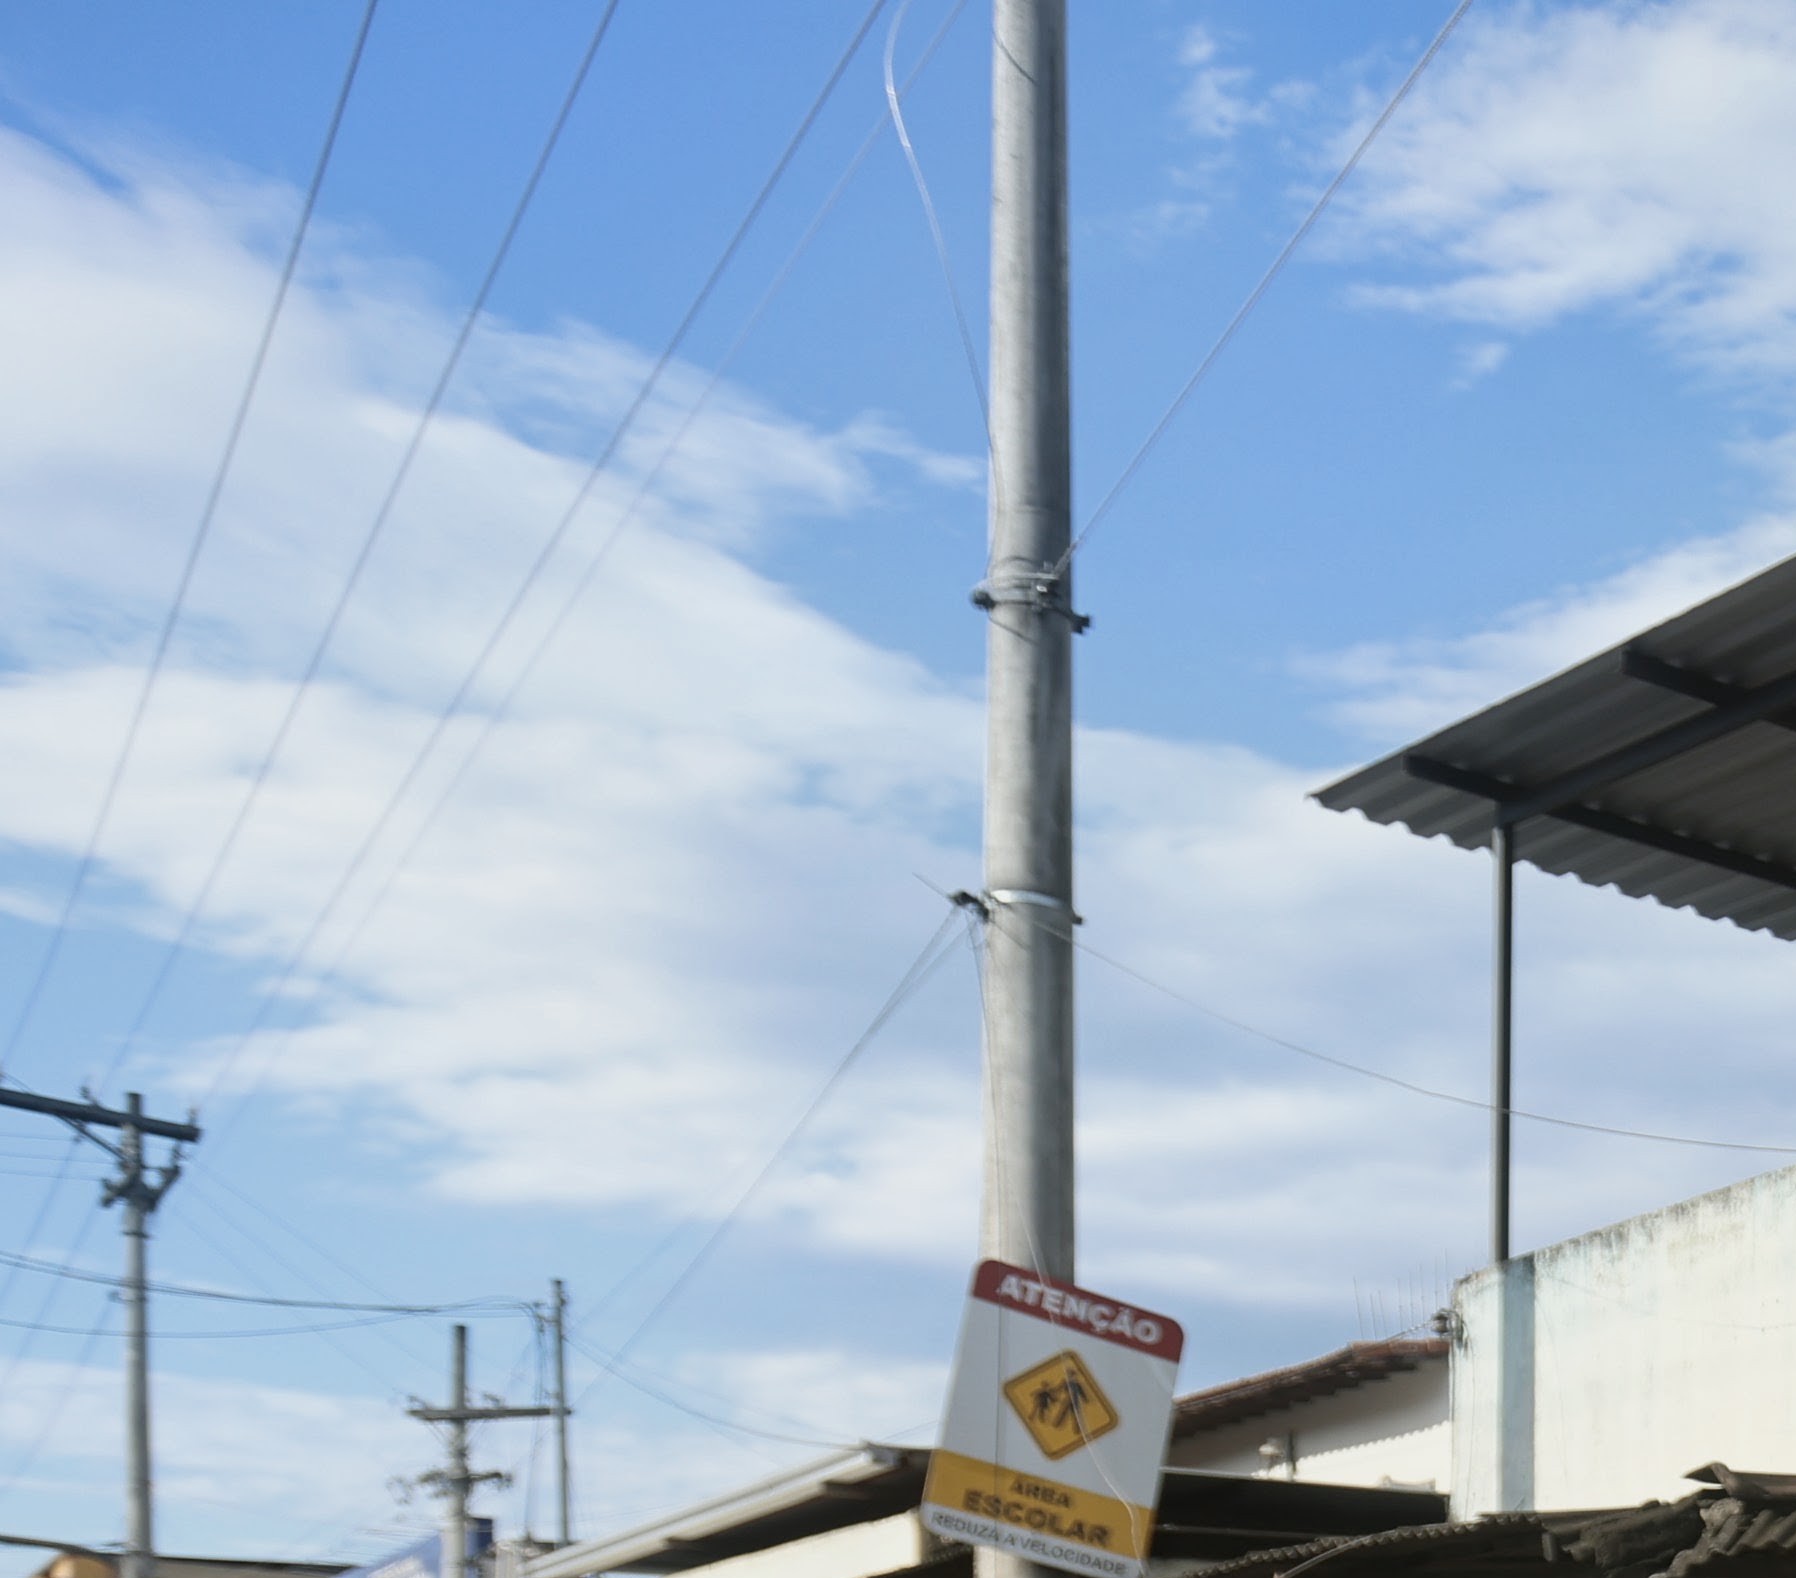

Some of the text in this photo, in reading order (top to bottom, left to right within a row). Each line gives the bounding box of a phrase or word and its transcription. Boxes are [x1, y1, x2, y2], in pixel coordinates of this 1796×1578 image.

[995, 1272, 1164, 1345] ATENÇÃO
[931, 1511, 1126, 1576] REDUZA A VELOCIDADE
[963, 1487, 1110, 1549] ESCOLAR
